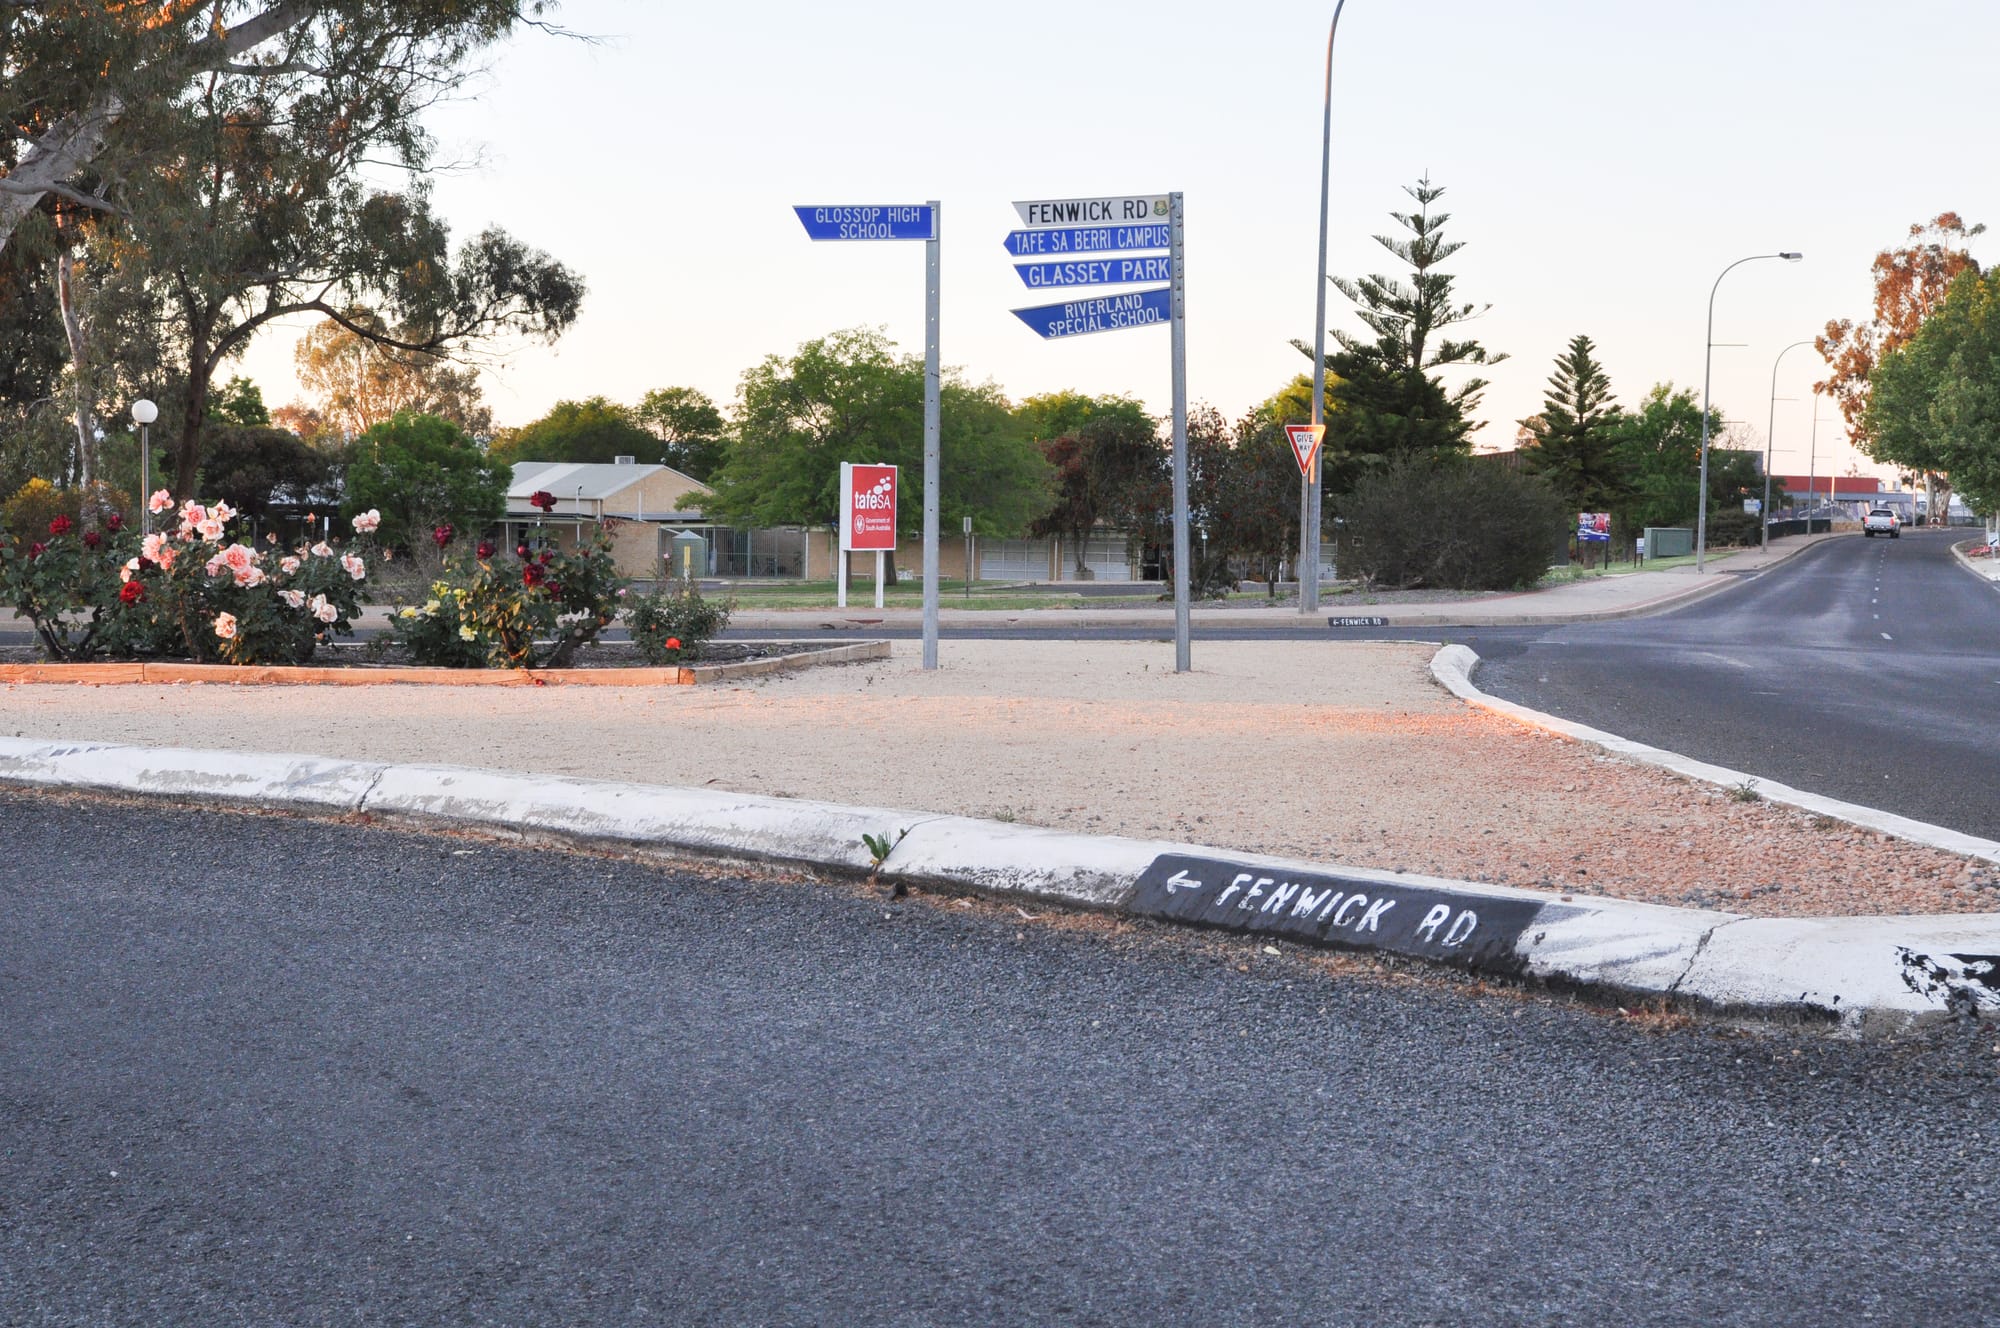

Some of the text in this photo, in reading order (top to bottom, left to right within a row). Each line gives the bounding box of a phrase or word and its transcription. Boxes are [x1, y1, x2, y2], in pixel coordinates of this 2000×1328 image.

[815, 207, 920, 223] GLOSSOP HIGH
[1029, 200, 1148, 223] FENWICK RD
[839, 223, 896, 239] SCHOOL
[1014, 226, 1169, 253] TAFE SA BERRI CAMPUS
[1028, 258, 1170, 286] GLASSEY PARK
[1065, 294, 1142, 319] RIVERLAND
[1048, 306, 1164, 337] SPECIAL SCHOOL
[1296, 434, 1313, 443] GIVE
[1341, 618, 1369, 626] FENWICK
[1215, 872, 1478, 948] FENWICK RD
